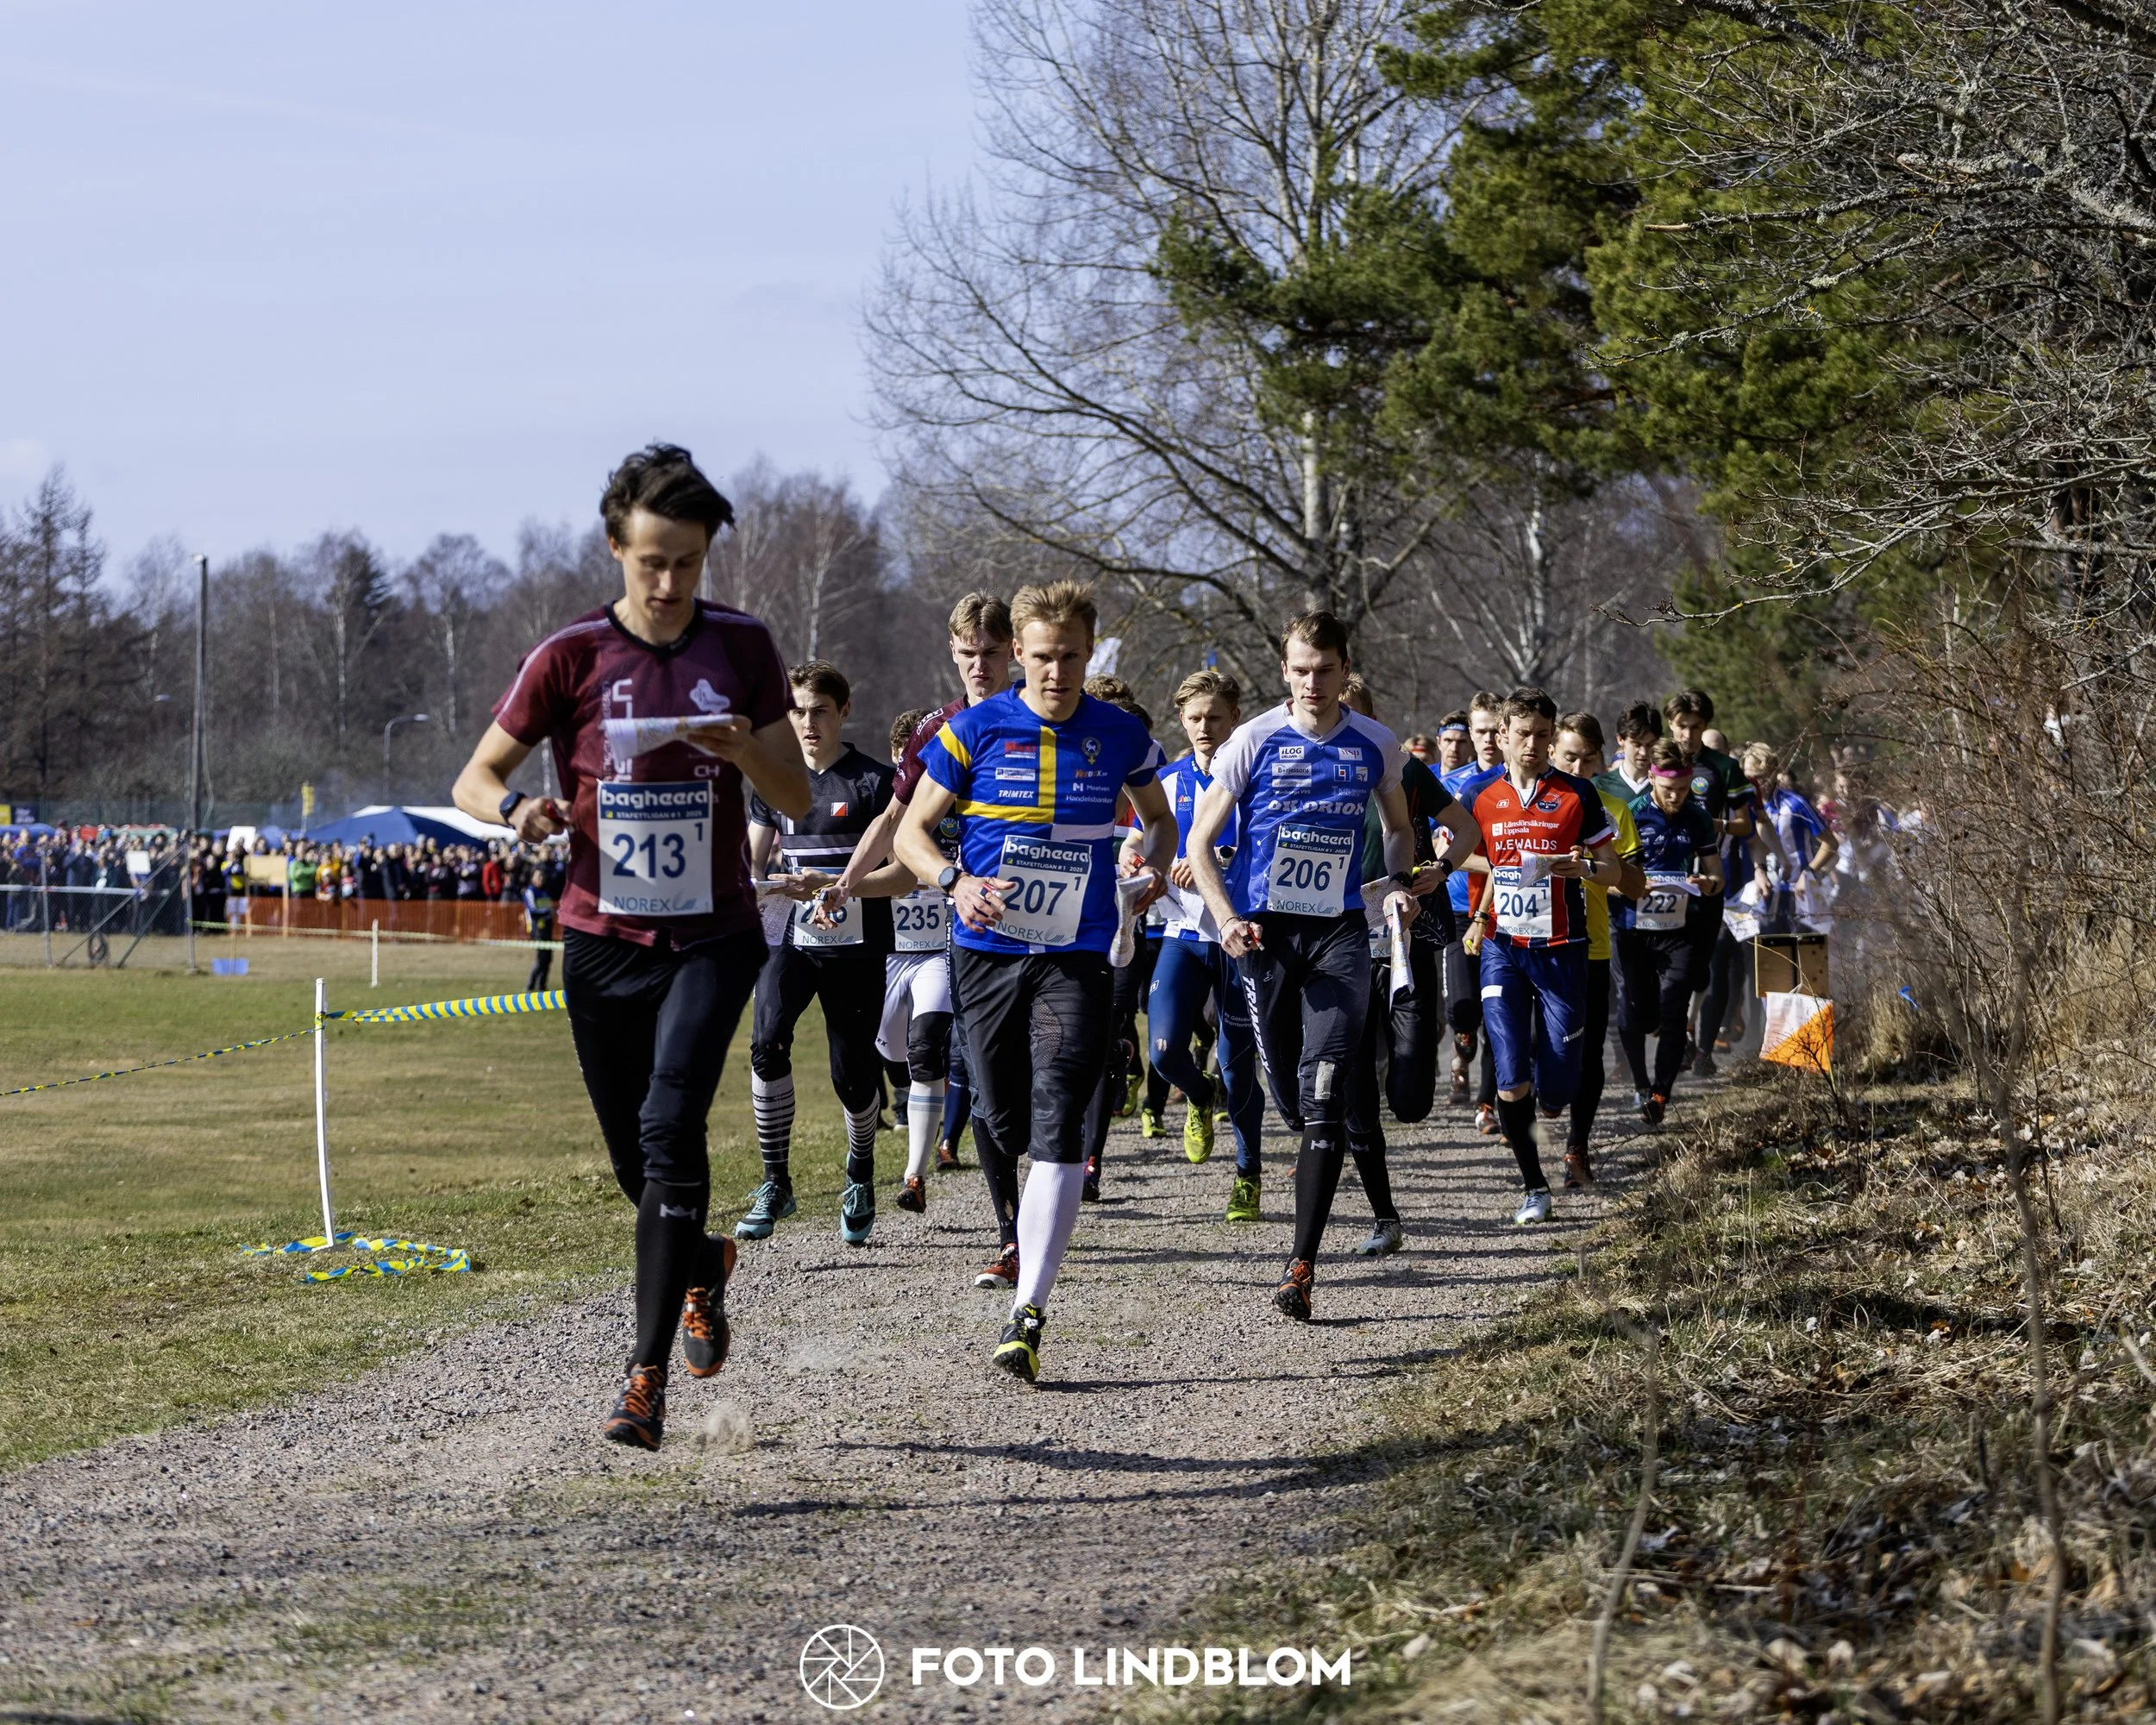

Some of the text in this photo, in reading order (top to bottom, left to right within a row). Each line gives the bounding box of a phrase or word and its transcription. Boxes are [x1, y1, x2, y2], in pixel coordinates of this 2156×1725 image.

[601, 789, 708, 809] bagheera
[999, 790, 1034, 799] TRIMTEX
[1268, 800, 1298, 812] OK
[1504, 819, 1560, 829] Länsförsäkringar
[1504, 826, 1530, 835] Uppsala
[1281, 827, 1351, 845] bagheera
[612, 822, 704, 879] 213 1
[1006, 841, 1089, 862] bagheera
[1289, 844, 1326, 852] STAFETTLIGAN
[1016, 859, 1057, 870] STAFETTLIGAN
[1276, 856, 1345, 892] 206 1
[1003, 876, 1081, 916] 207 1
[1499, 889, 1547, 918] 204 1
[1641, 894, 1677, 913] 222
[614, 895, 670, 913] NOREX
[1276, 900, 1316, 913] NOREX
[896, 904, 940, 932] 235
[1642, 920, 1670, 929] NOREX
[998, 920, 1044, 941] NOREX
[1502, 925, 1530, 935] NOREX
[802, 935, 837, 944] NOREX
[899, 940, 931, 949] NOREX
